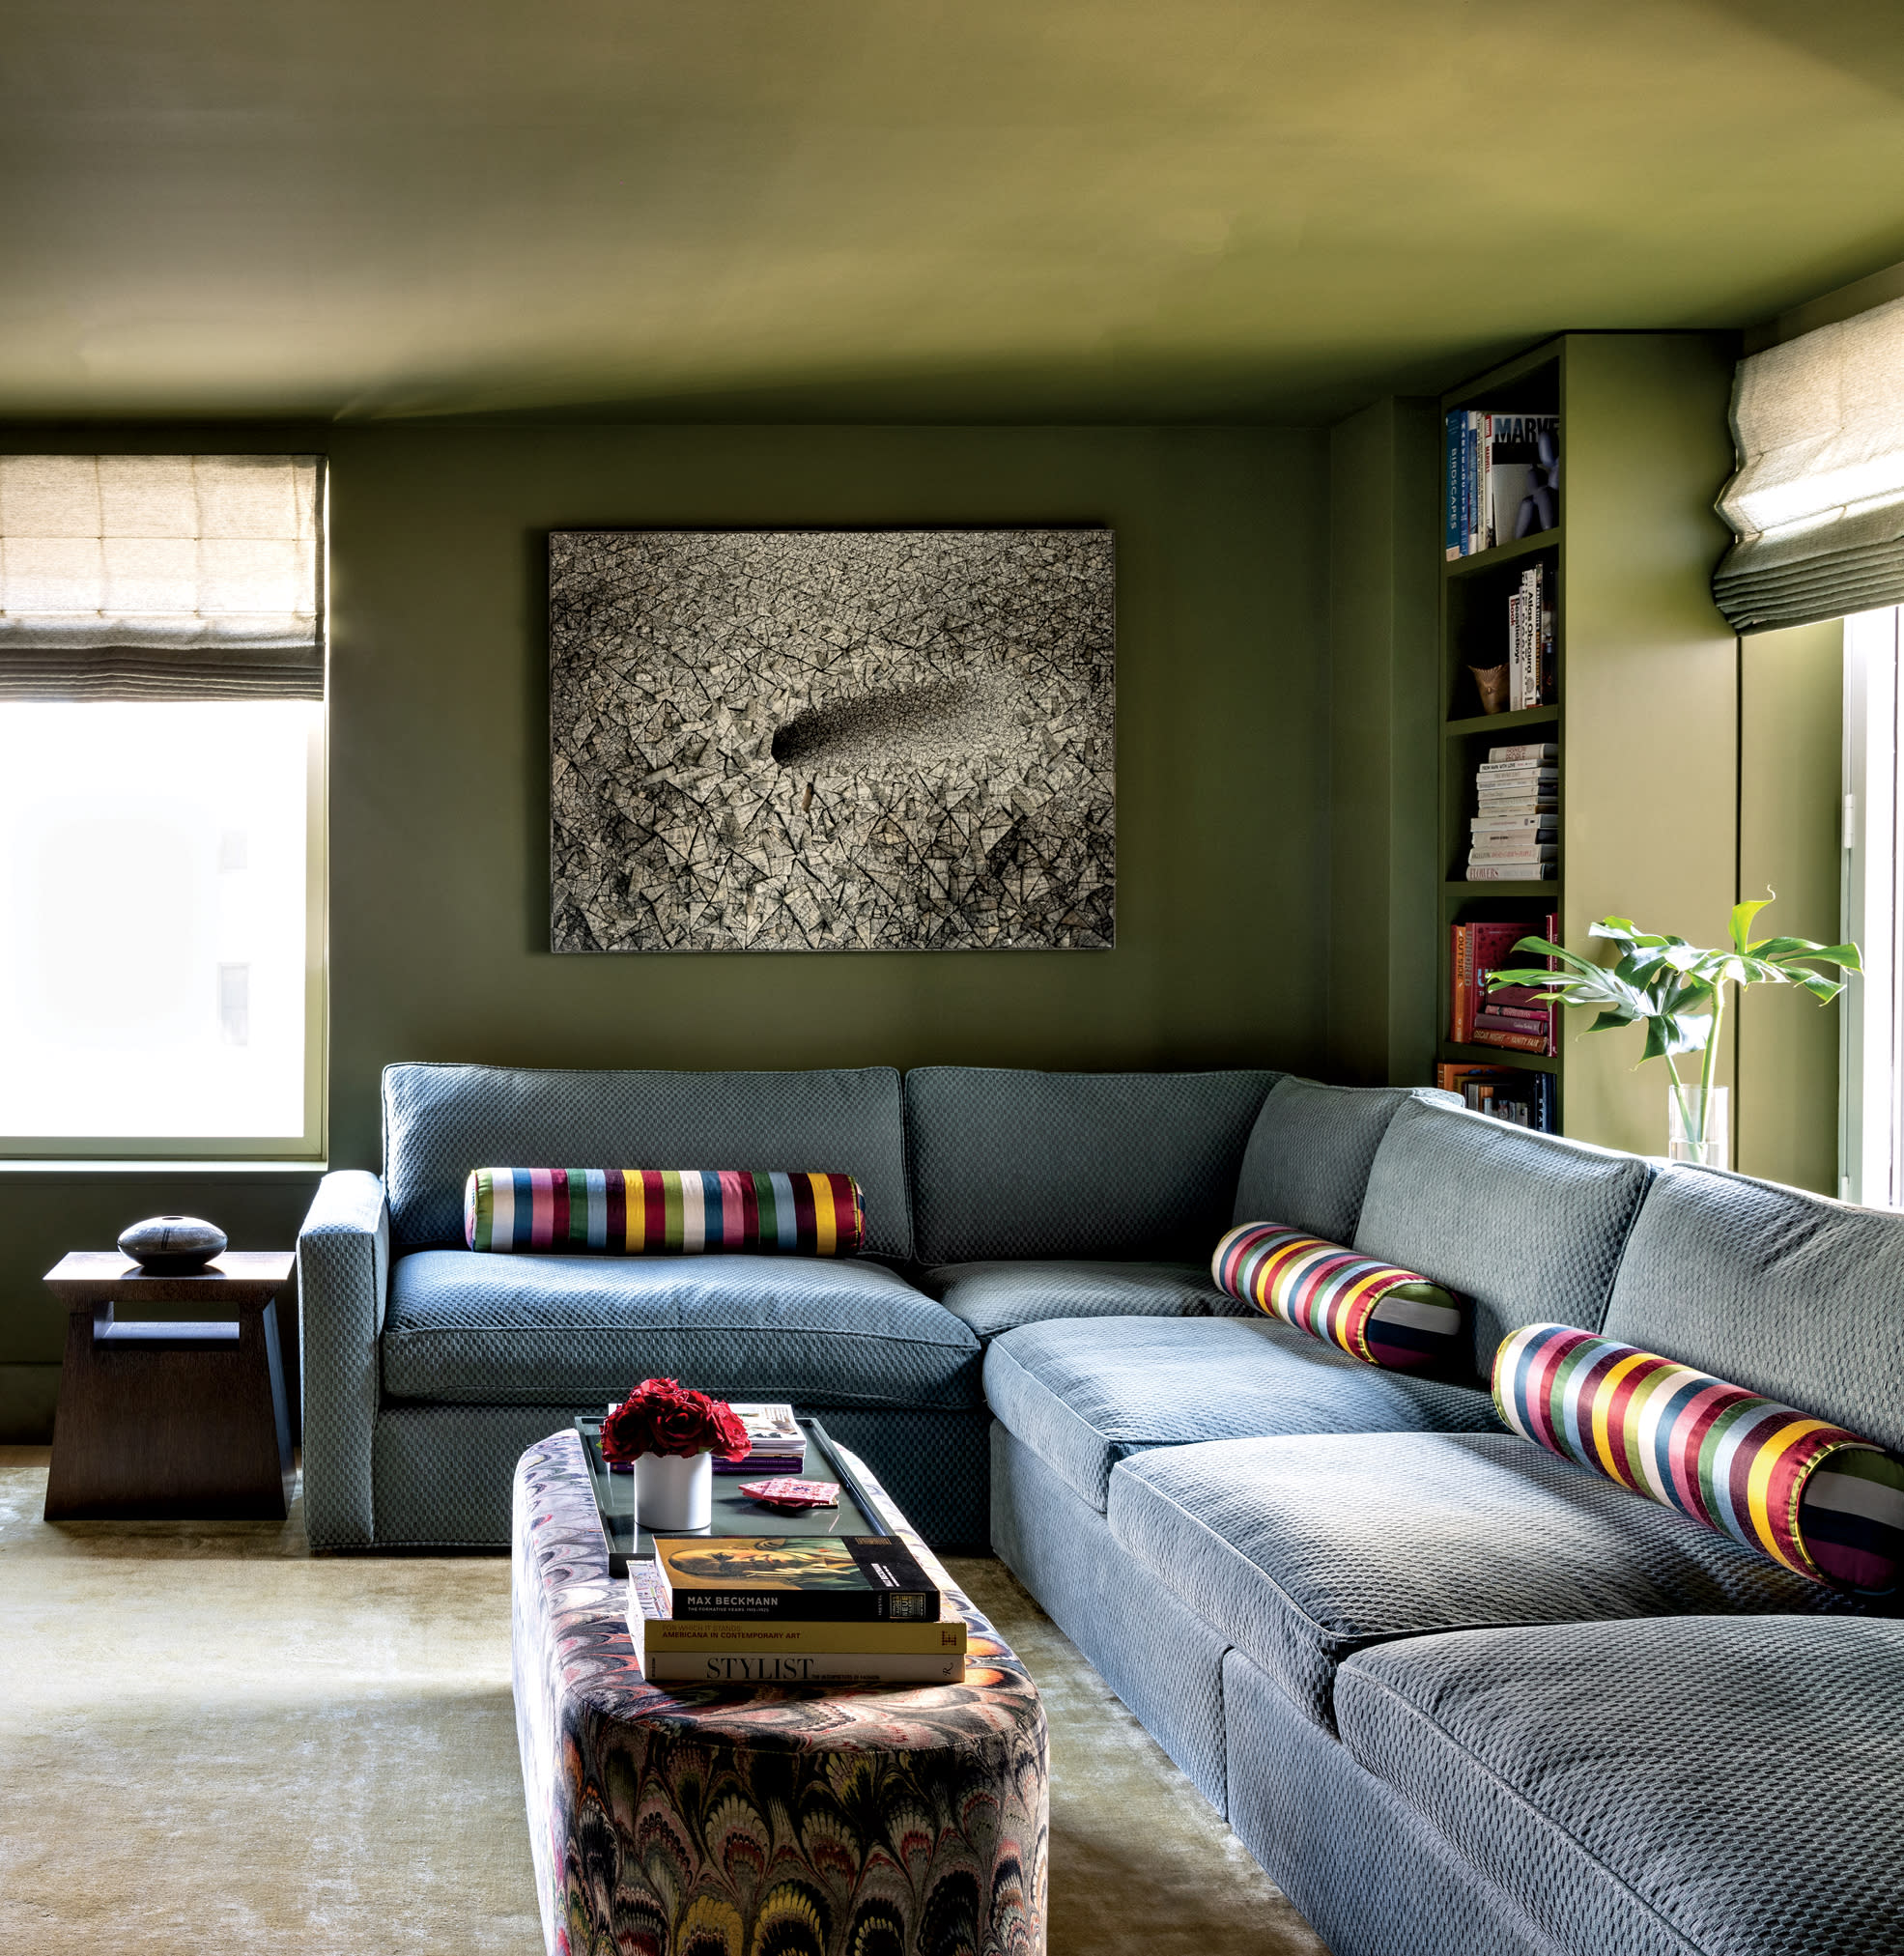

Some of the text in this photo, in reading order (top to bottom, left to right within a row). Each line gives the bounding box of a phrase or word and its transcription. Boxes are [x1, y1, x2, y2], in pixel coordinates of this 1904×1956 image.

[1469, 867, 1499, 880] FLOWERS
[1464, 930, 1473, 986] UNBORED
[1473, 1030, 1489, 1040] OSCAR
[1489, 1033, 1505, 1043] NIGHT
[1511, 1035, 1527, 1046] VANITY
[1527, 1038, 1540, 1047] FAIR
[687, 1596, 778, 1605] MAX BECKMANN
[663, 1624, 676, 1632] FOR
[678, 1624, 702, 1632] WHICH
[704, 1624, 711, 1632] IT
[706, 1657, 813, 1680] STYLIST
